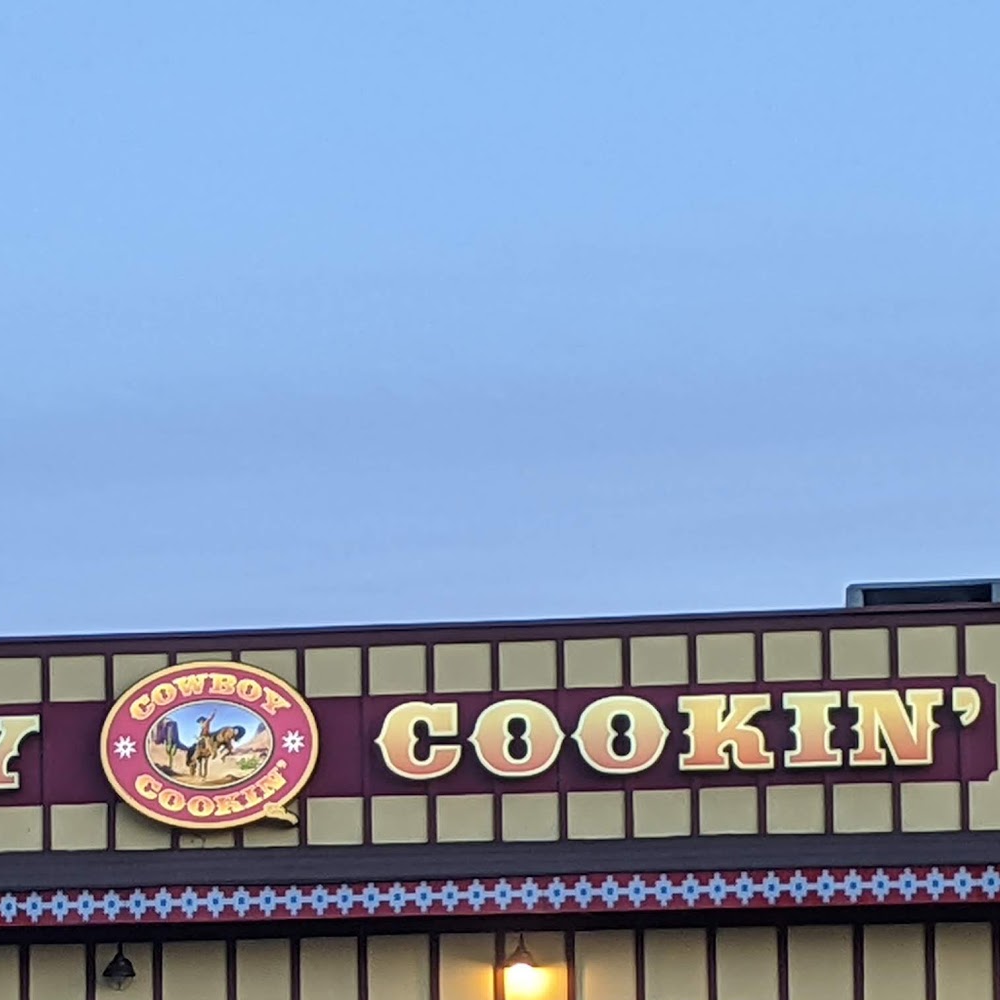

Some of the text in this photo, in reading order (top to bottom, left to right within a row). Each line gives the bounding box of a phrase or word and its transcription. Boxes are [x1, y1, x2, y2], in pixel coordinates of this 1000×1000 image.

[130, 673, 292, 720] COWBOY
[374, 687, 981, 779] COOKIN'
[135, 759, 288, 817] COOKIN'
